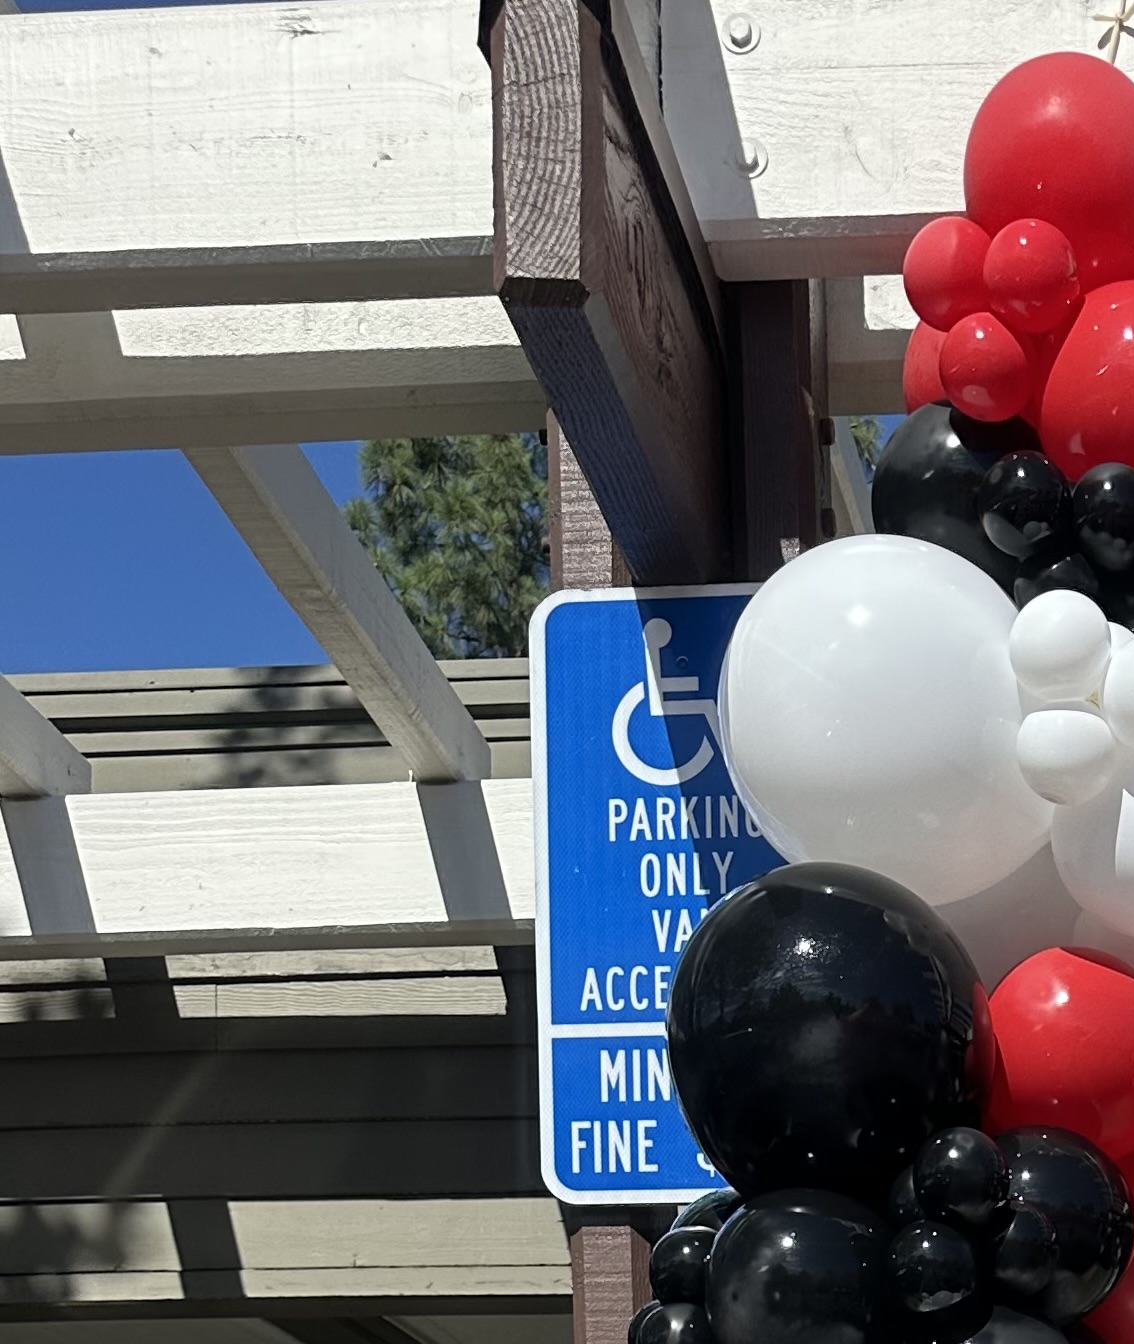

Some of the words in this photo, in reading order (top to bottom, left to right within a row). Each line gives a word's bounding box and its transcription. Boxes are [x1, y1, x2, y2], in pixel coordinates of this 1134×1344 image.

[640, 851, 734, 898] ONLY
[652, 908, 709, 953] VA
[571, 1119, 659, 1174] FINE
